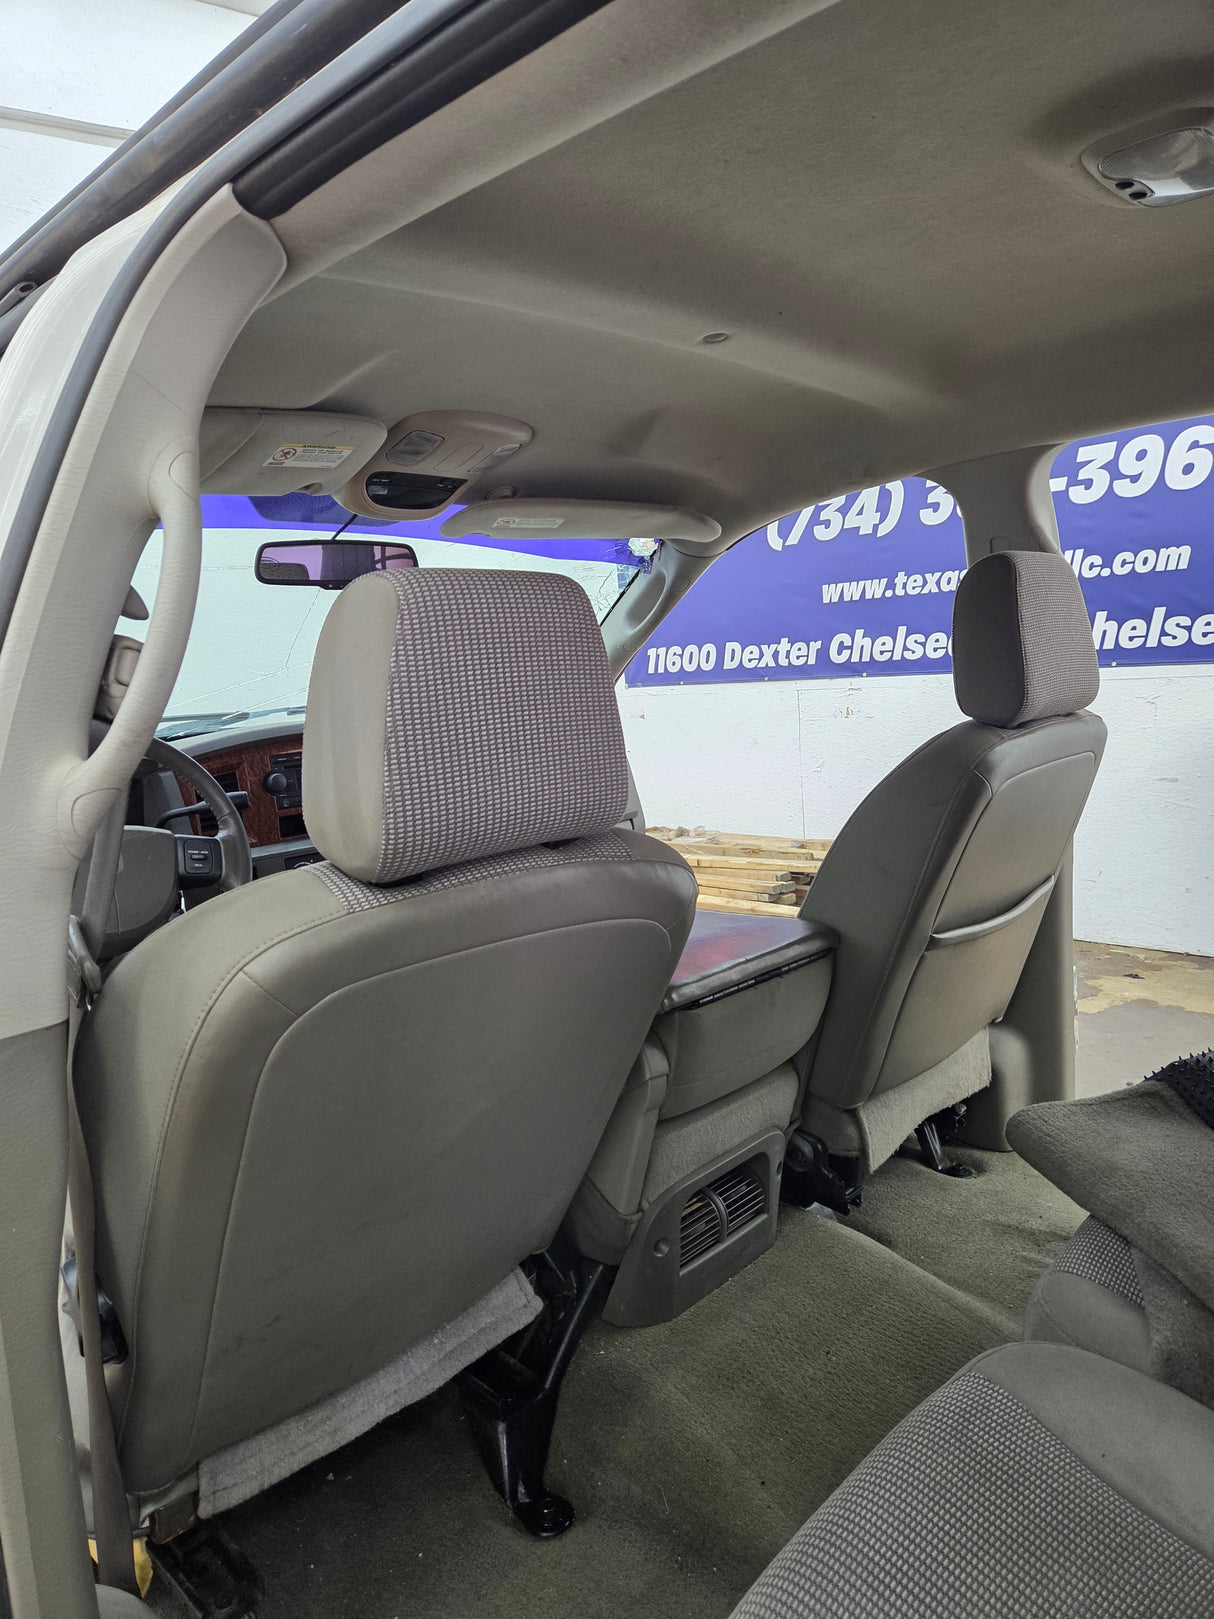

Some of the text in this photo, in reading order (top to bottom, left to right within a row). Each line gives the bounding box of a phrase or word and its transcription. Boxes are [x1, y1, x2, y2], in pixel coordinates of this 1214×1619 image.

[920, 480, 963, 526] 3
[647, 643, 716, 674] 11600
[723, 637, 822, 670] Dexter
[829, 626, 952, 664] Chelse
